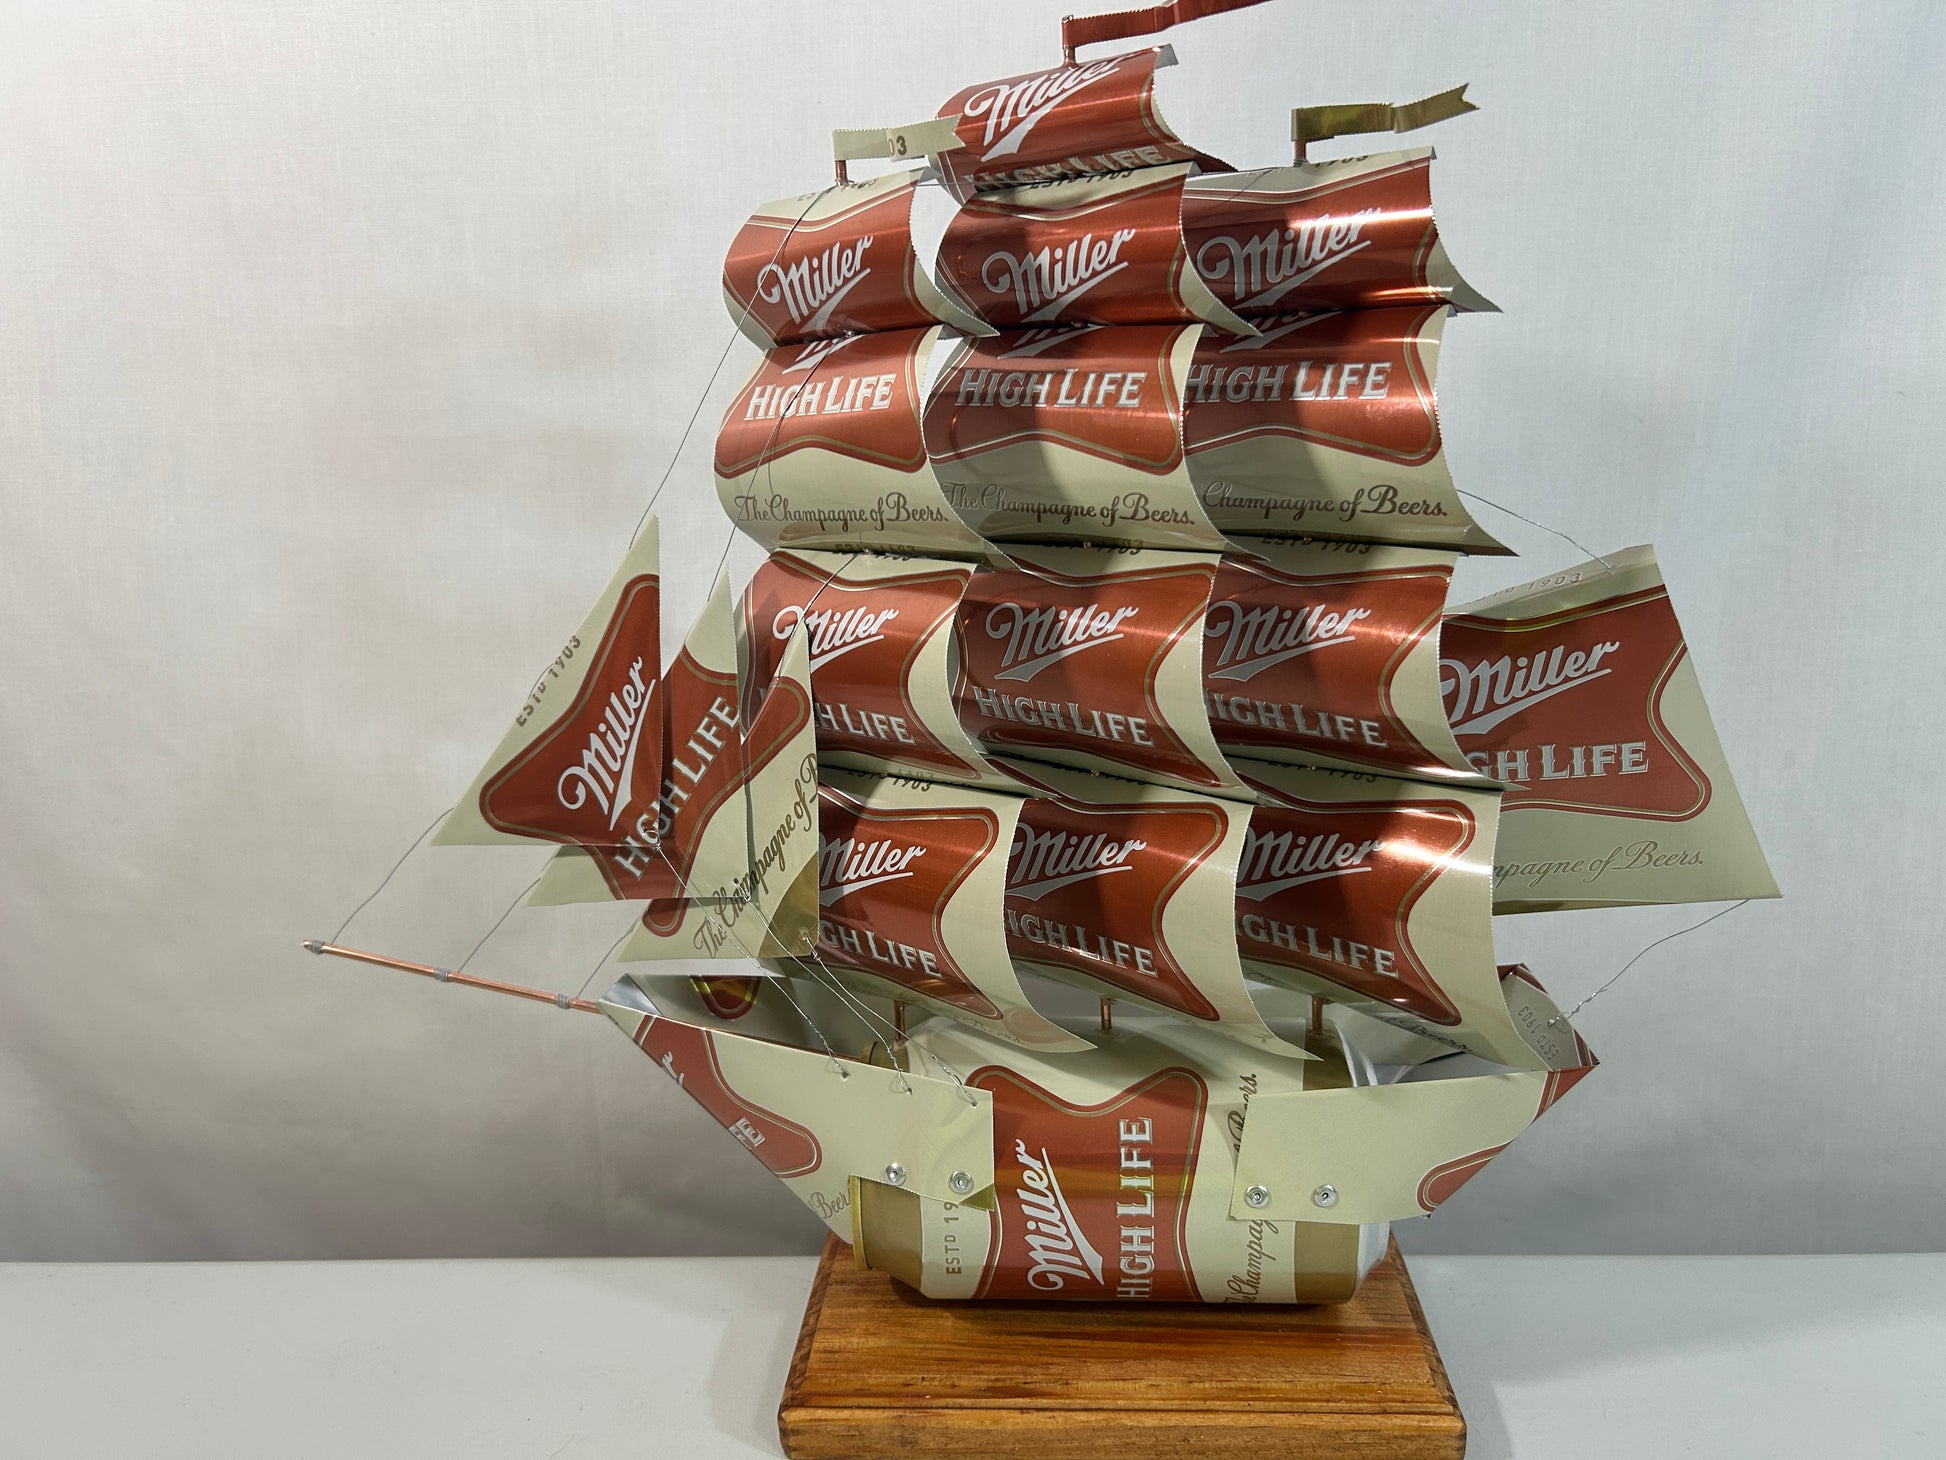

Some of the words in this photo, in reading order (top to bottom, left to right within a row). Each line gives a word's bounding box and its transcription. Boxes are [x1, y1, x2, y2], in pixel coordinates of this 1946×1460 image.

[964, 53, 1138, 150] Miller
[757, 234, 873, 325] Miller
[982, 228, 1136, 314] Miller
[1197, 207, 1381, 302] Miller
[744, 381, 824, 421] HIGH
[821, 373, 897, 416] LIFE
[954, 368, 1055, 408] HIGH
[1053, 368, 1148, 408] LIFE
[1184, 361, 1296, 404] HIGH
[1292, 360, 1392, 401] LIFE
[734, 494, 769, 523] The
[765, 493, 867, 532] Champagne
[865, 505, 886, 532] of
[880, 491, 949, 524] Beers.
[940, 481, 979, 511] The
[976, 483, 1097, 526] Champagne
[1099, 496, 1121, 527] of
[1118, 491, 1196, 526] Beers.
[1202, 480, 1336, 521] Champagne
[1339, 487, 1365, 522] of
[1359, 484, 1449, 518] Beers.
[1527, 571, 1584, 592] 1903
[772, 604, 900, 658] Miller
[985, 602, 1139, 668] Miller
[1203, 600, 1371, 668] Miller
[1438, 641, 1620, 724] Miller
[557, 656, 651, 822] Miller
[672, 695, 740, 787] LIFE
[838, 703, 917, 745] LIFE
[972, 681, 1068, 732] HIGH
[1066, 701, 1156, 748] LIFE
[1288, 702, 1389, 749] LIFE
[1464, 749, 1531, 782] GH
[1538, 741, 1650, 781] LIFE
[693, 915, 727, 959] The
[793, 777, 813, 832] of
[819, 832, 927, 887] Miller
[1006, 822, 1147, 884] Miller
[1236, 826, 1386, 884] Miller
[1494, 858, 1584, 888] pagne
[1583, 845, 1622, 883] of
[1612, 840, 1704, 871] Beers.
[819, 918, 867, 958] GH
[862, 928, 944, 979] LIFE
[1005, 907, 1074, 951] IGH
[1071, 924, 1159, 978] LIFE
[1235, 911, 1301, 952] GH
[1302, 925, 1399, 979] LIFE
[1517, 1005, 1542, 1034] 1903
[1116, 1116, 1155, 1218] LIFE
[809, 1188, 852, 1219] Beer
[943, 1202, 960, 1224] 19
[1014, 1137, 1096, 1291] Miller
[943, 1233, 963, 1276] ESTD
[1116, 1224, 1155, 1298] HIGH
